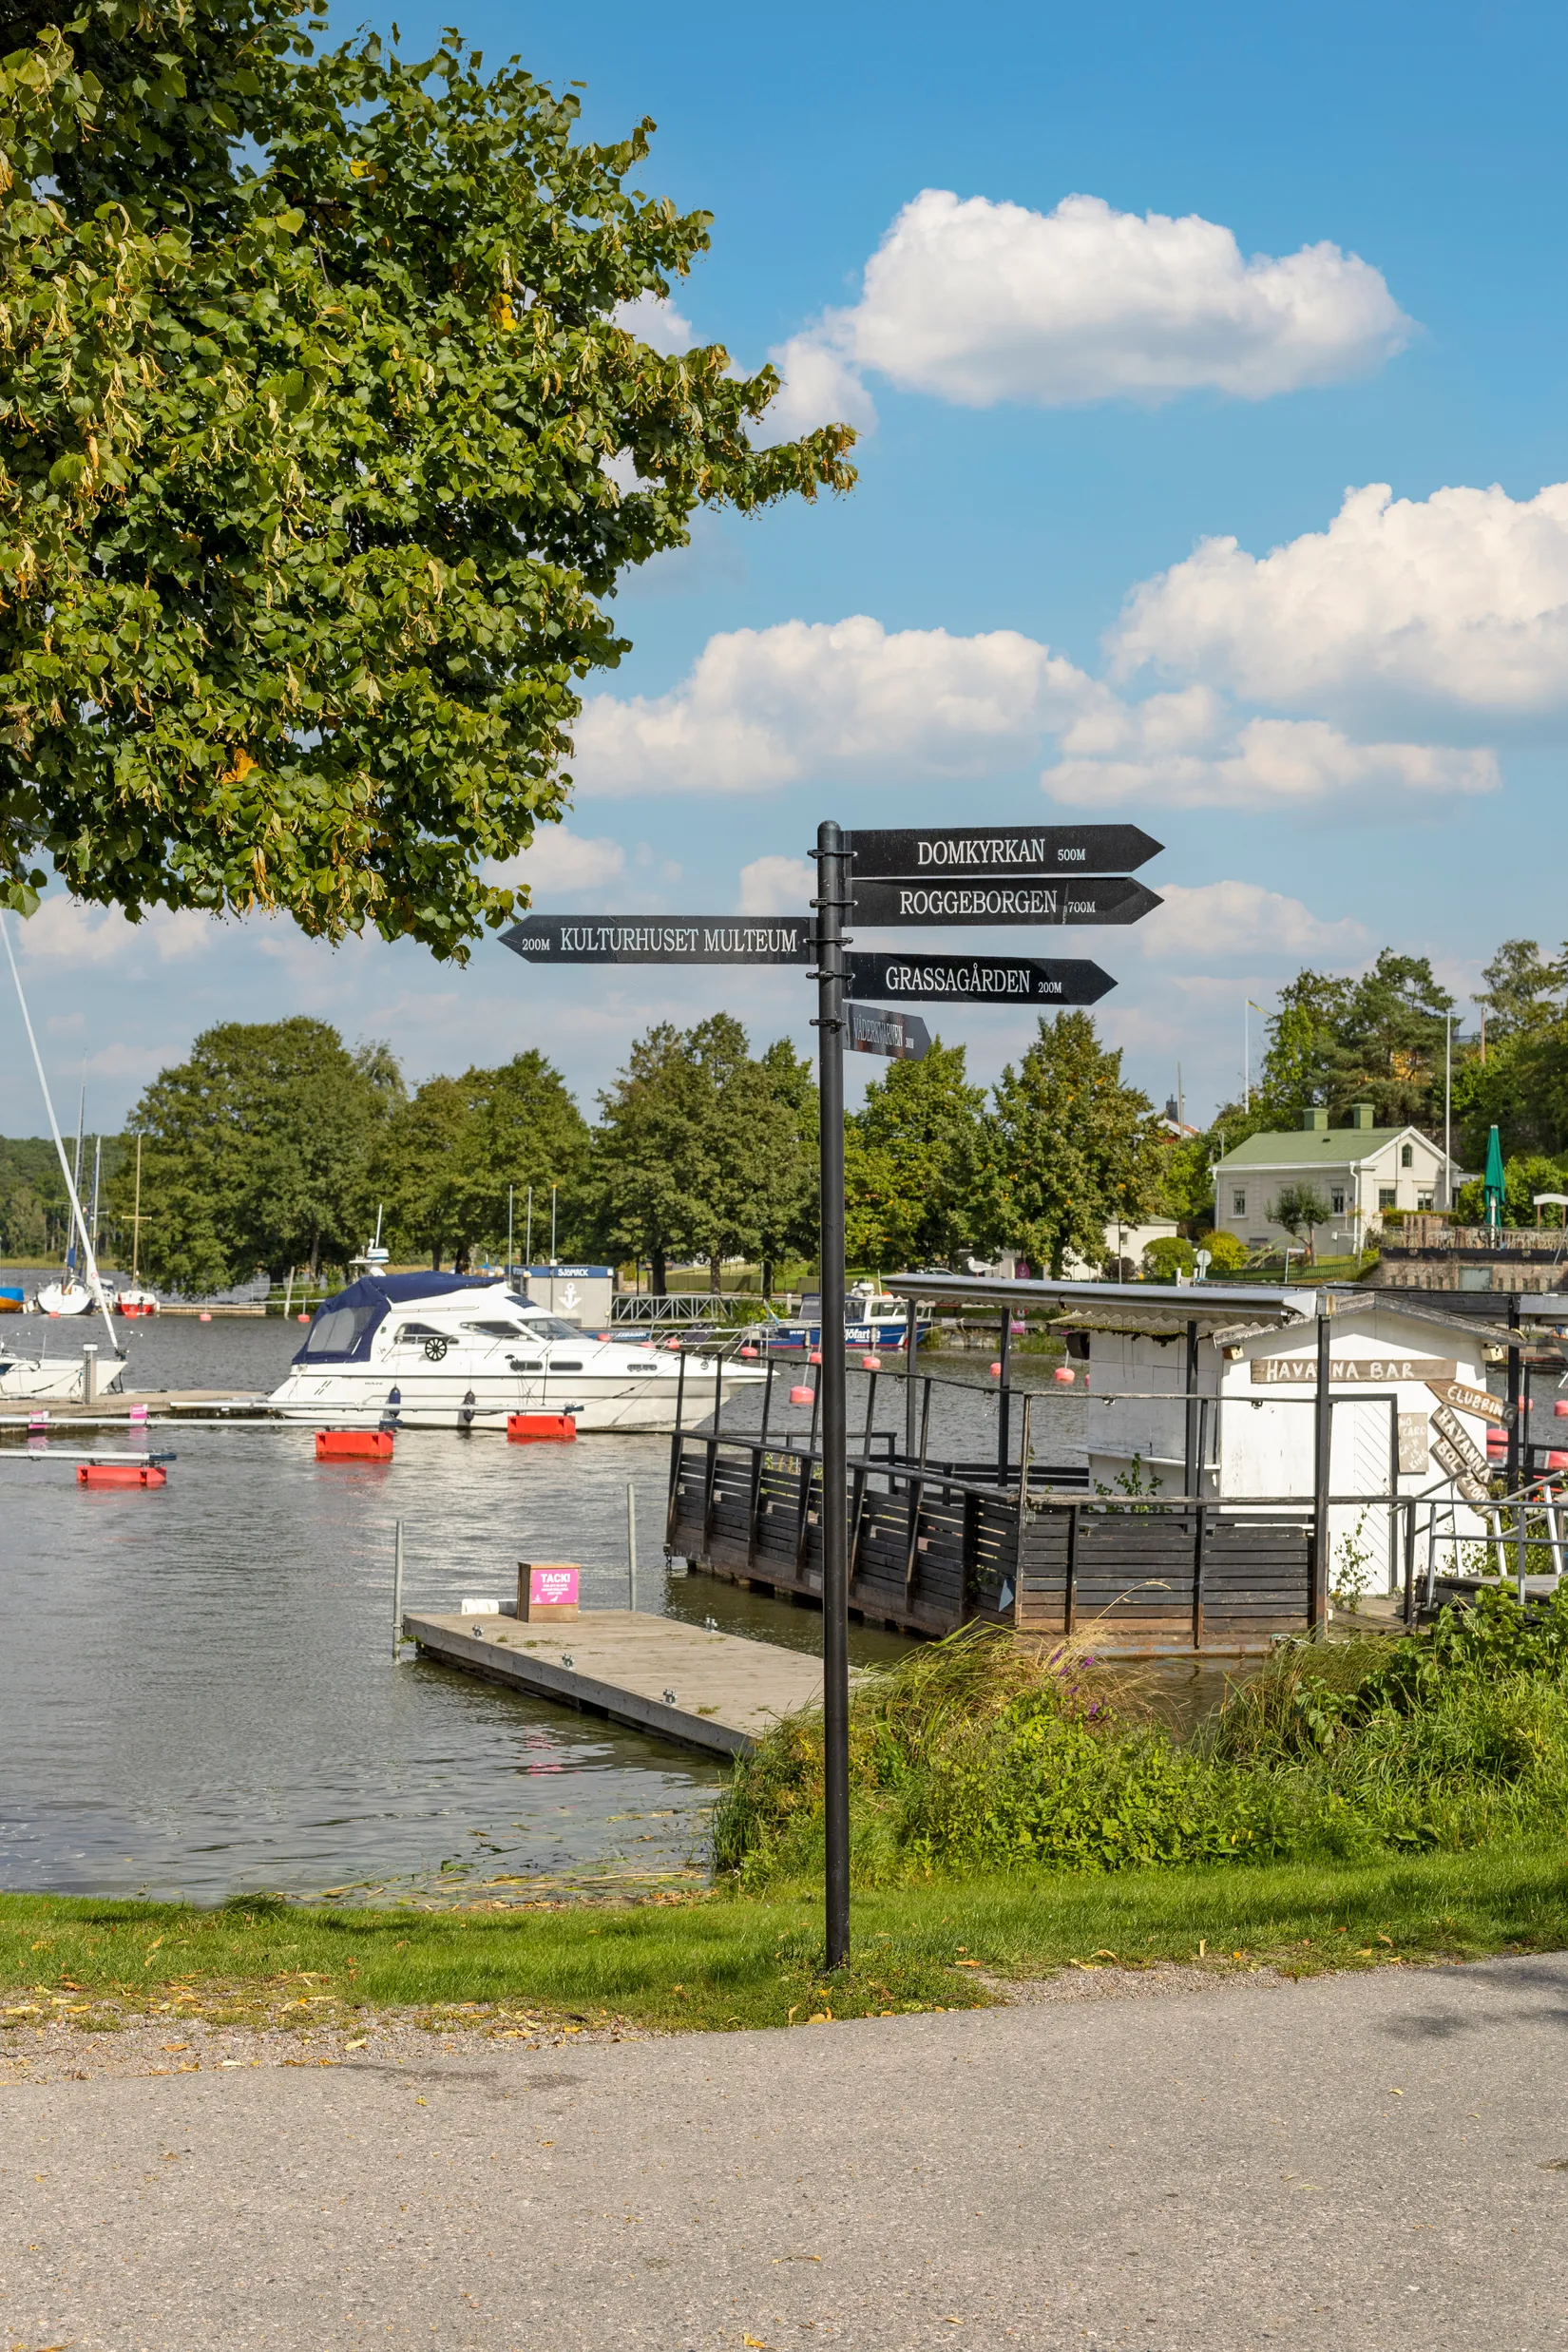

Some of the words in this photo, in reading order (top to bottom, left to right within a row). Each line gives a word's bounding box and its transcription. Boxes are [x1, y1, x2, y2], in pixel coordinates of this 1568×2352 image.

[918, 839, 1045, 865] DOMKYRKAN
[1057, 849, 1086, 861] 500M
[900, 890, 1058, 914] ROGGEBORGEN
[1067, 901, 1096, 913] 700M
[522, 938, 550, 950] 200M
[561, 927, 699, 951] KULTURHUSET
[703, 929, 797, 952] MULTEUM
[886, 963, 1031, 993] GRASSAGÅRDEN
[1038, 982, 1062, 994] 200M
[1267, 1360, 1359, 1381] HAVANA
[1370, 1362, 1414, 1379] BAR
[1447, 1386, 1514, 1422] CLUBBING
[1436, 1440, 1459, 1473] BOL
[1439, 1408, 1491, 1483] HAVANNA
[540, 1573, 571, 1583] TACK!
